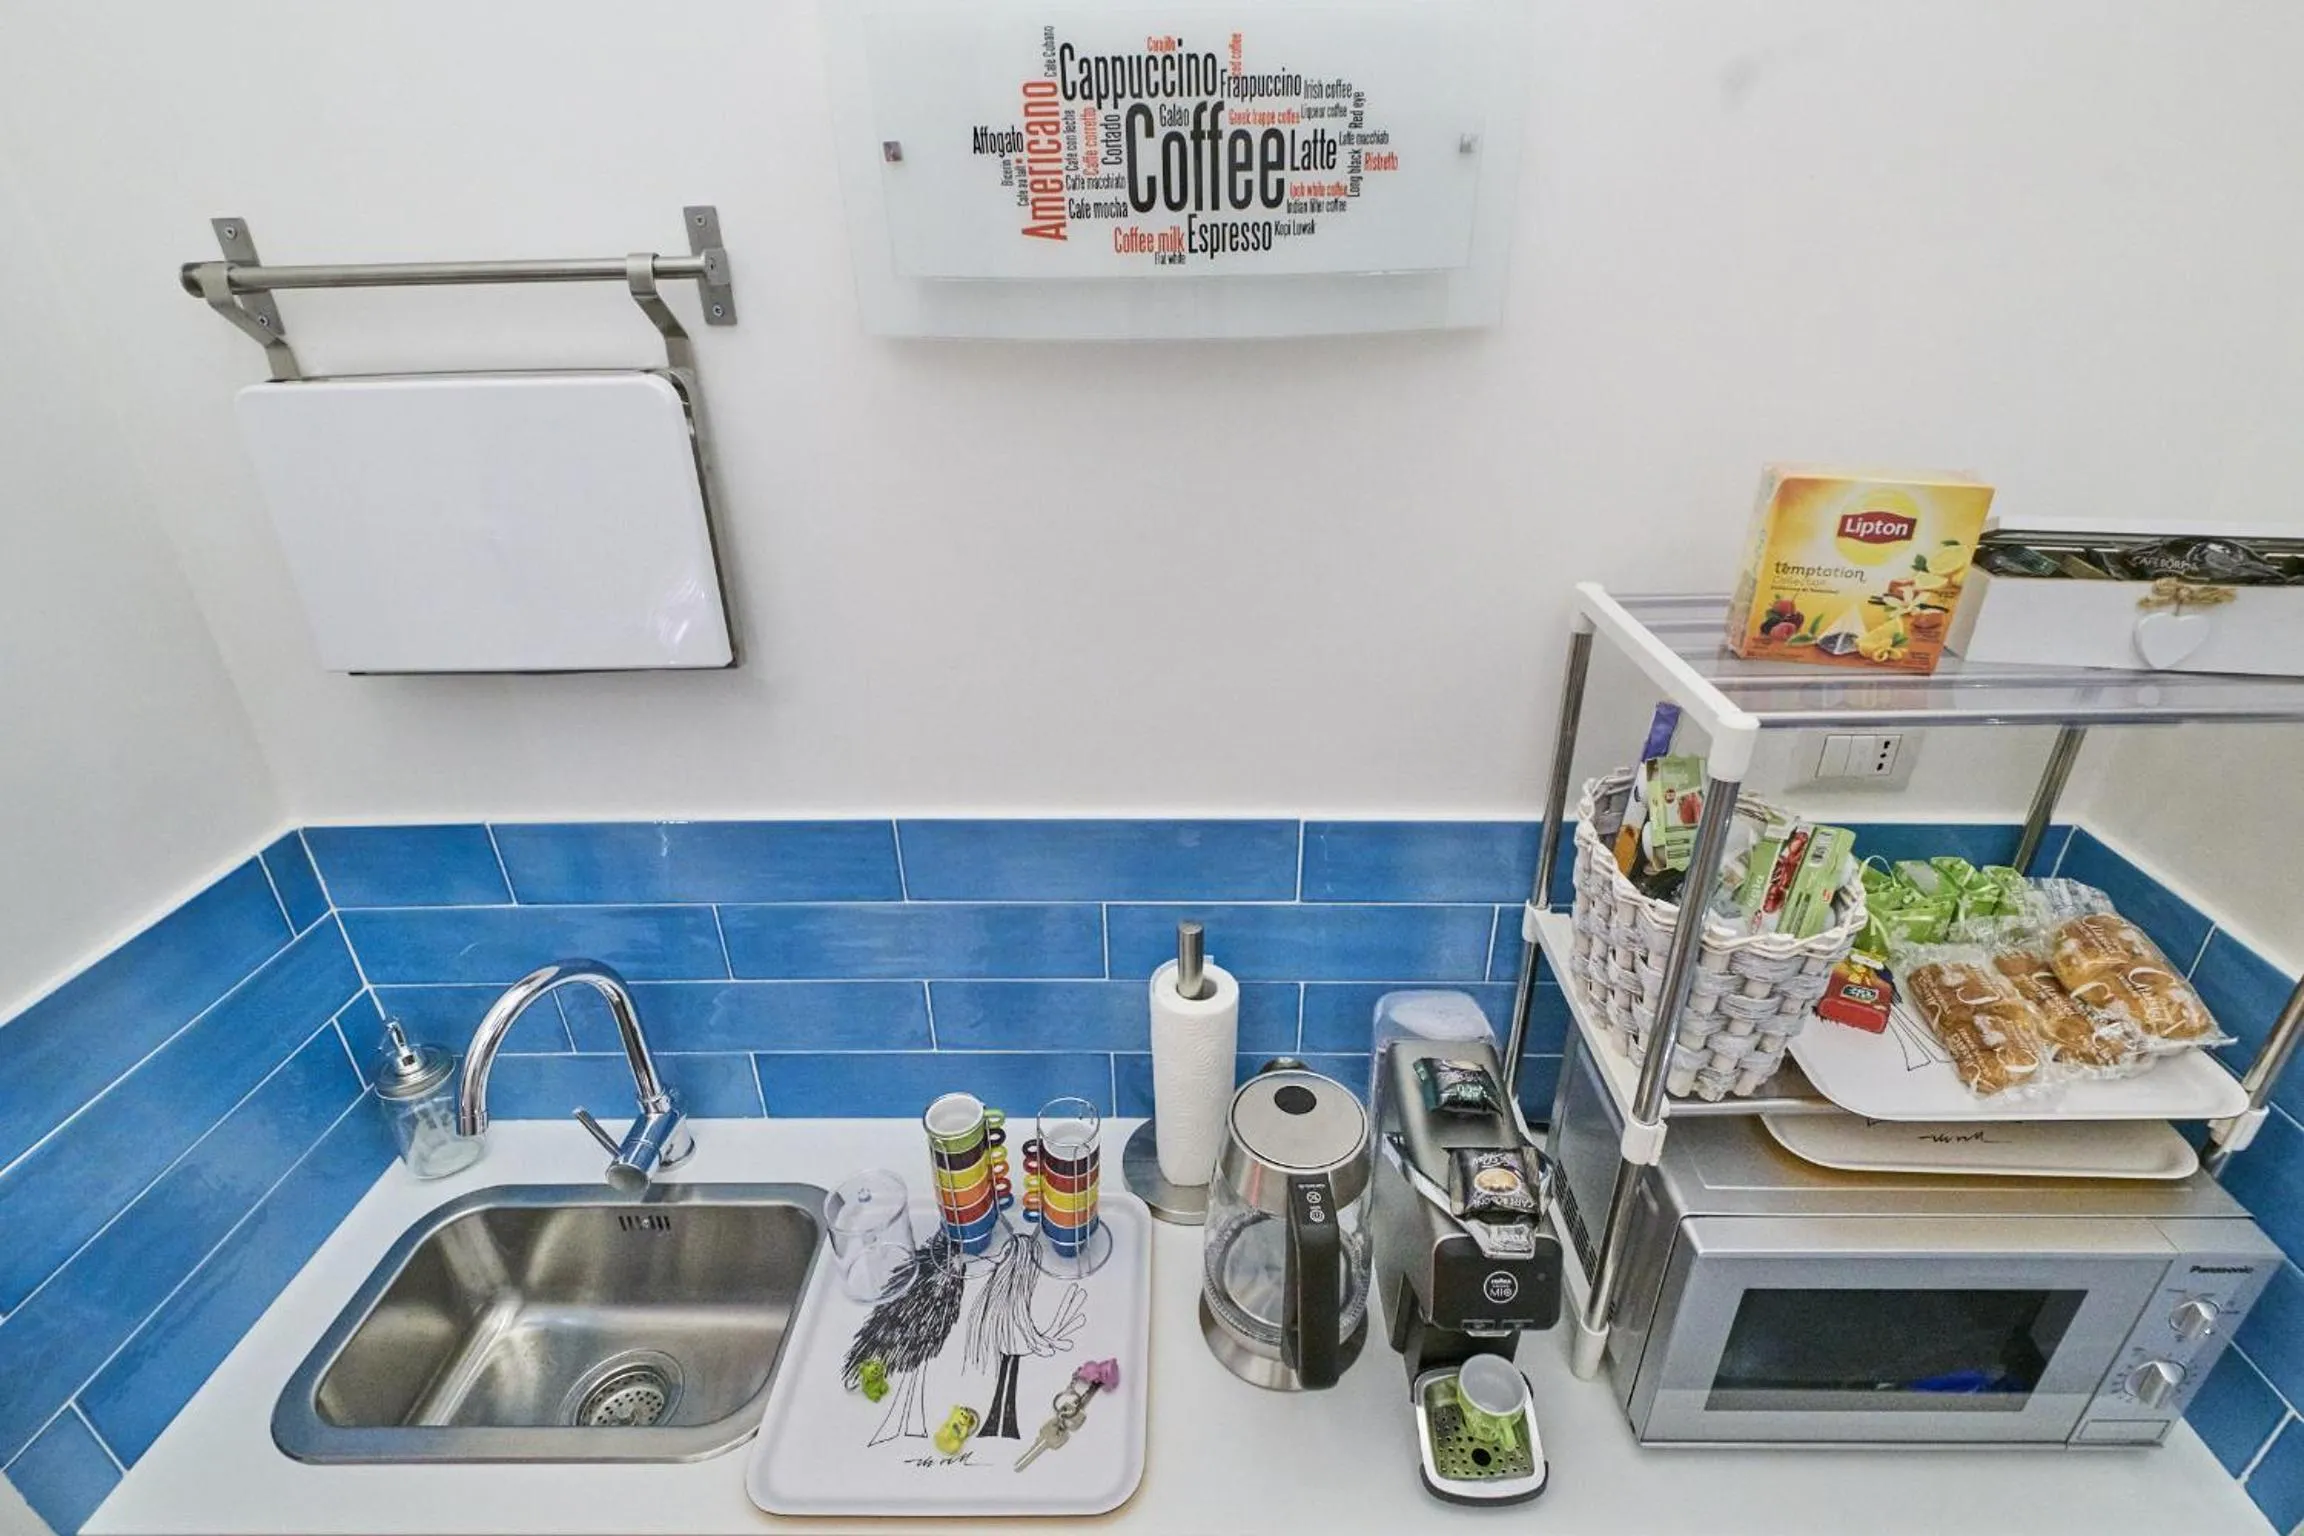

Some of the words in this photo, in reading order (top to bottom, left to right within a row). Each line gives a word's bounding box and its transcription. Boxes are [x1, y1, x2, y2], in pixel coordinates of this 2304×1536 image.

[1059, 38, 1217, 110] Cappuccino
[1220, 67, 1302, 102] Frappuccino
[1304, 79, 1324, 100] Irish
[1325, 79, 1353, 100] coffee
[1351, 91, 1367, 109] eye
[1062, 109, 1076, 133] leche
[1277, 108, 1300, 124] coffee
[1326, 103, 1348, 119] coffee
[1347, 110, 1364, 129] Red
[1080, 106, 1097, 147] corretto
[1339, 130, 1355, 146] Latte
[1356, 129, 1389, 145] macchiato
[973, 124, 1025, 158] Affogato
[1065, 134, 1077, 151] con
[1100, 113, 1123, 166] Cortado
[1290, 127, 1337, 171] Latte
[1015, 81, 1068, 241] Americano
[1125, 100, 1286, 213] Coffee
[1347, 148, 1362, 174] black
[1364, 151, 1400, 171] Ristretto
[1086, 173, 1127, 191] macchiato
[1347, 176, 1363, 198] Long
[1068, 198, 1092, 220] Cafe
[1093, 197, 1129, 219] mocha
[1325, 198, 1347, 213] coffee
[1114, 226, 1154, 254] Coffee
[1157, 225, 1185, 254] milk
[1187, 213, 1273, 260] Espresso
[1274, 219, 1292, 239] Kopi
[1154, 252, 1168, 265] Flat
[1168, 251, 1186, 265] white
[1844, 518, 1910, 538] Lipton
[1774, 562, 1867, 584] temptation
